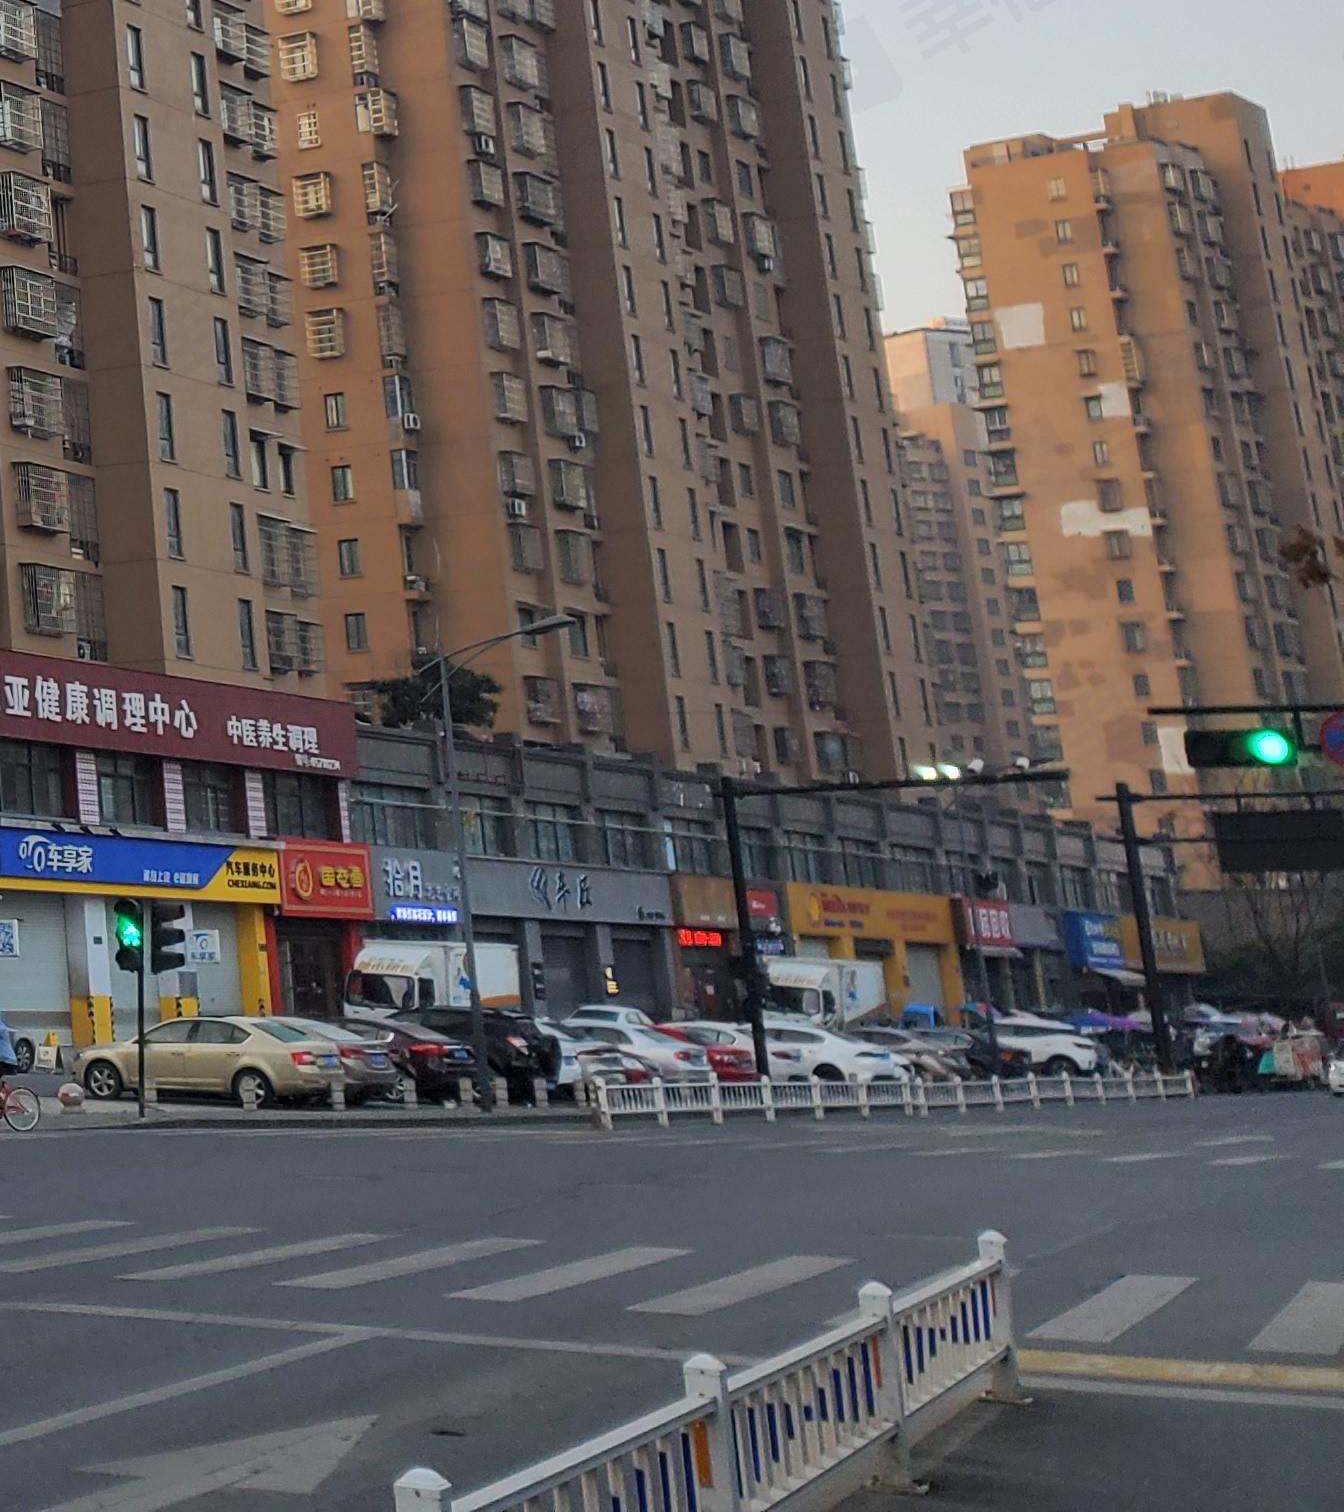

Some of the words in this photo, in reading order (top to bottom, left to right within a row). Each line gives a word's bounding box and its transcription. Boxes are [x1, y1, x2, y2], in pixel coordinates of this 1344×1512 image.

[227, 715, 320, 754] 中医养生调理
[47, 845, 93, 873] 车享家
[225, 861, 275, 878] 汽车服务中心
[383, 857, 423, 899] 拾月
